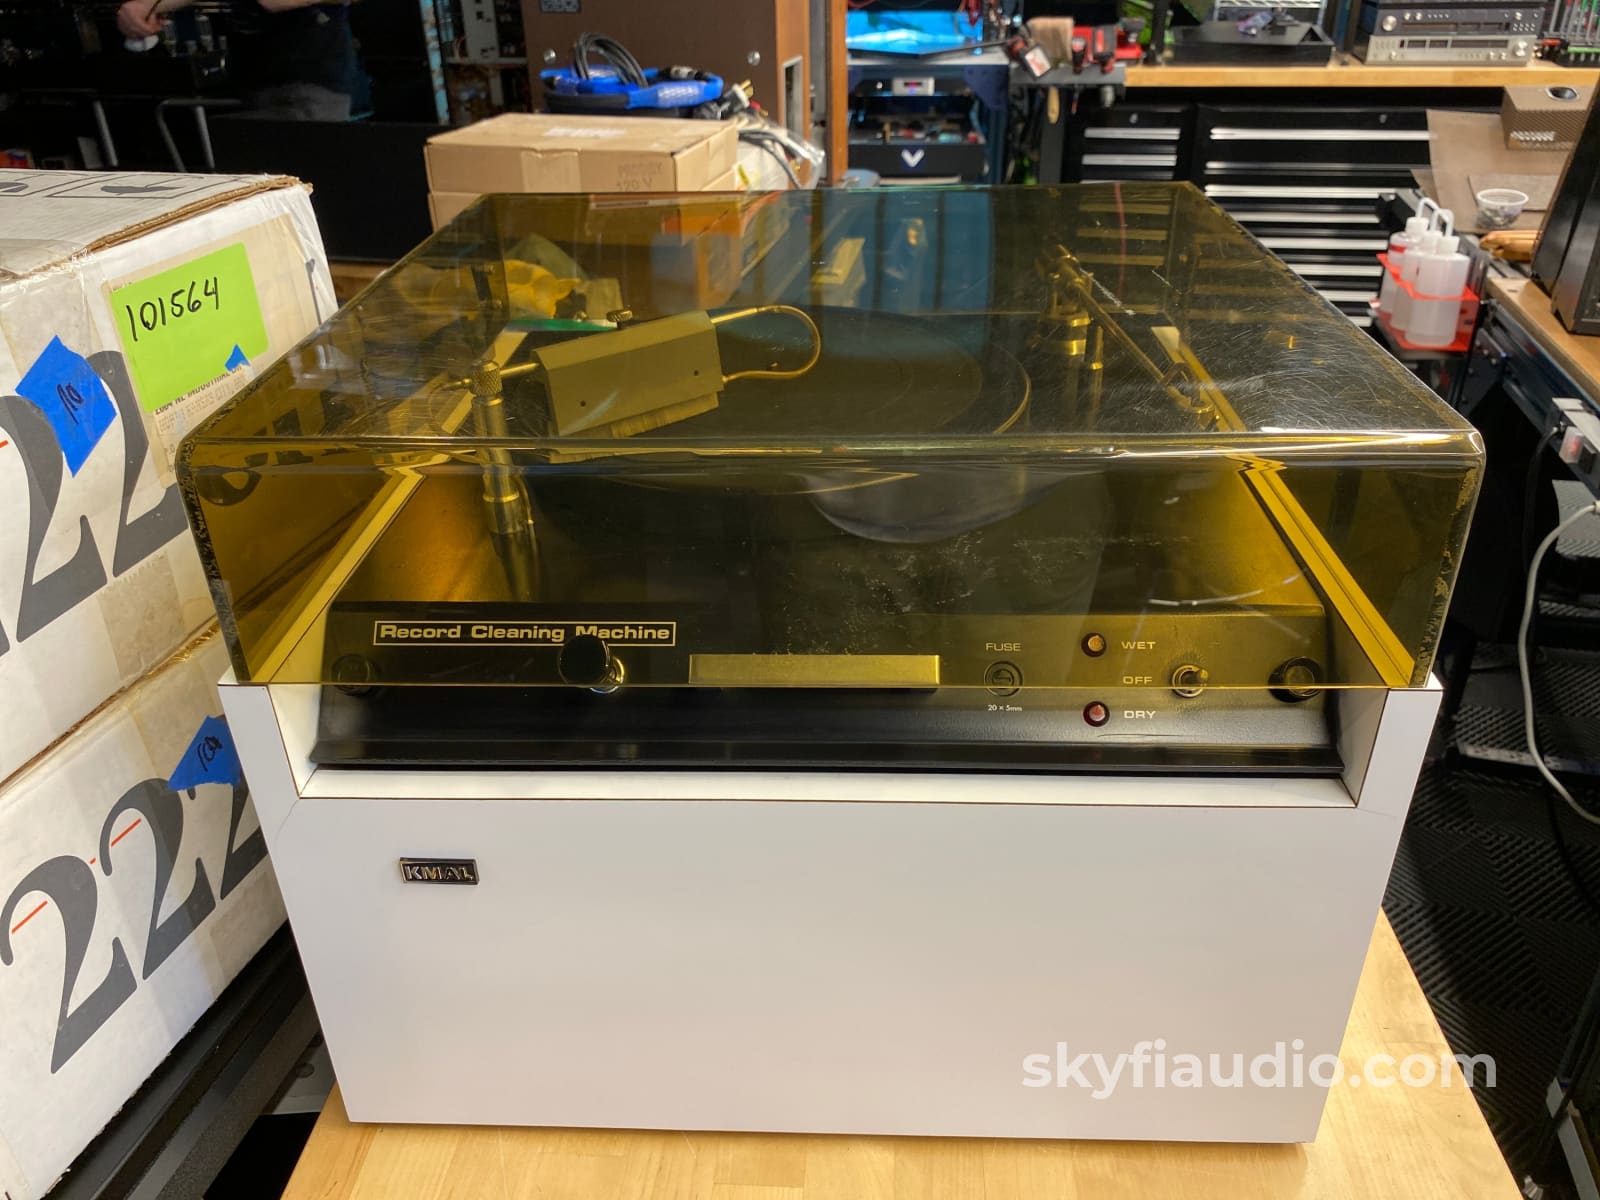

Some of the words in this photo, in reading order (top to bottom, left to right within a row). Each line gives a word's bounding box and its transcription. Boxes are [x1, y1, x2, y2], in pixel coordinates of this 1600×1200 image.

[126, 277, 219, 341] 101564
[379, 624, 461, 639] Record
[470, 624, 565, 643] Cleaning
[575, 625, 670, 640] Machine
[985, 642, 1022, 652] FUSE
[1121, 641, 1156, 650] WET
[1122, 676, 1153, 685] OFF
[1123, 710, 1156, 720] DRY
[404, 865, 473, 881] KMAL
